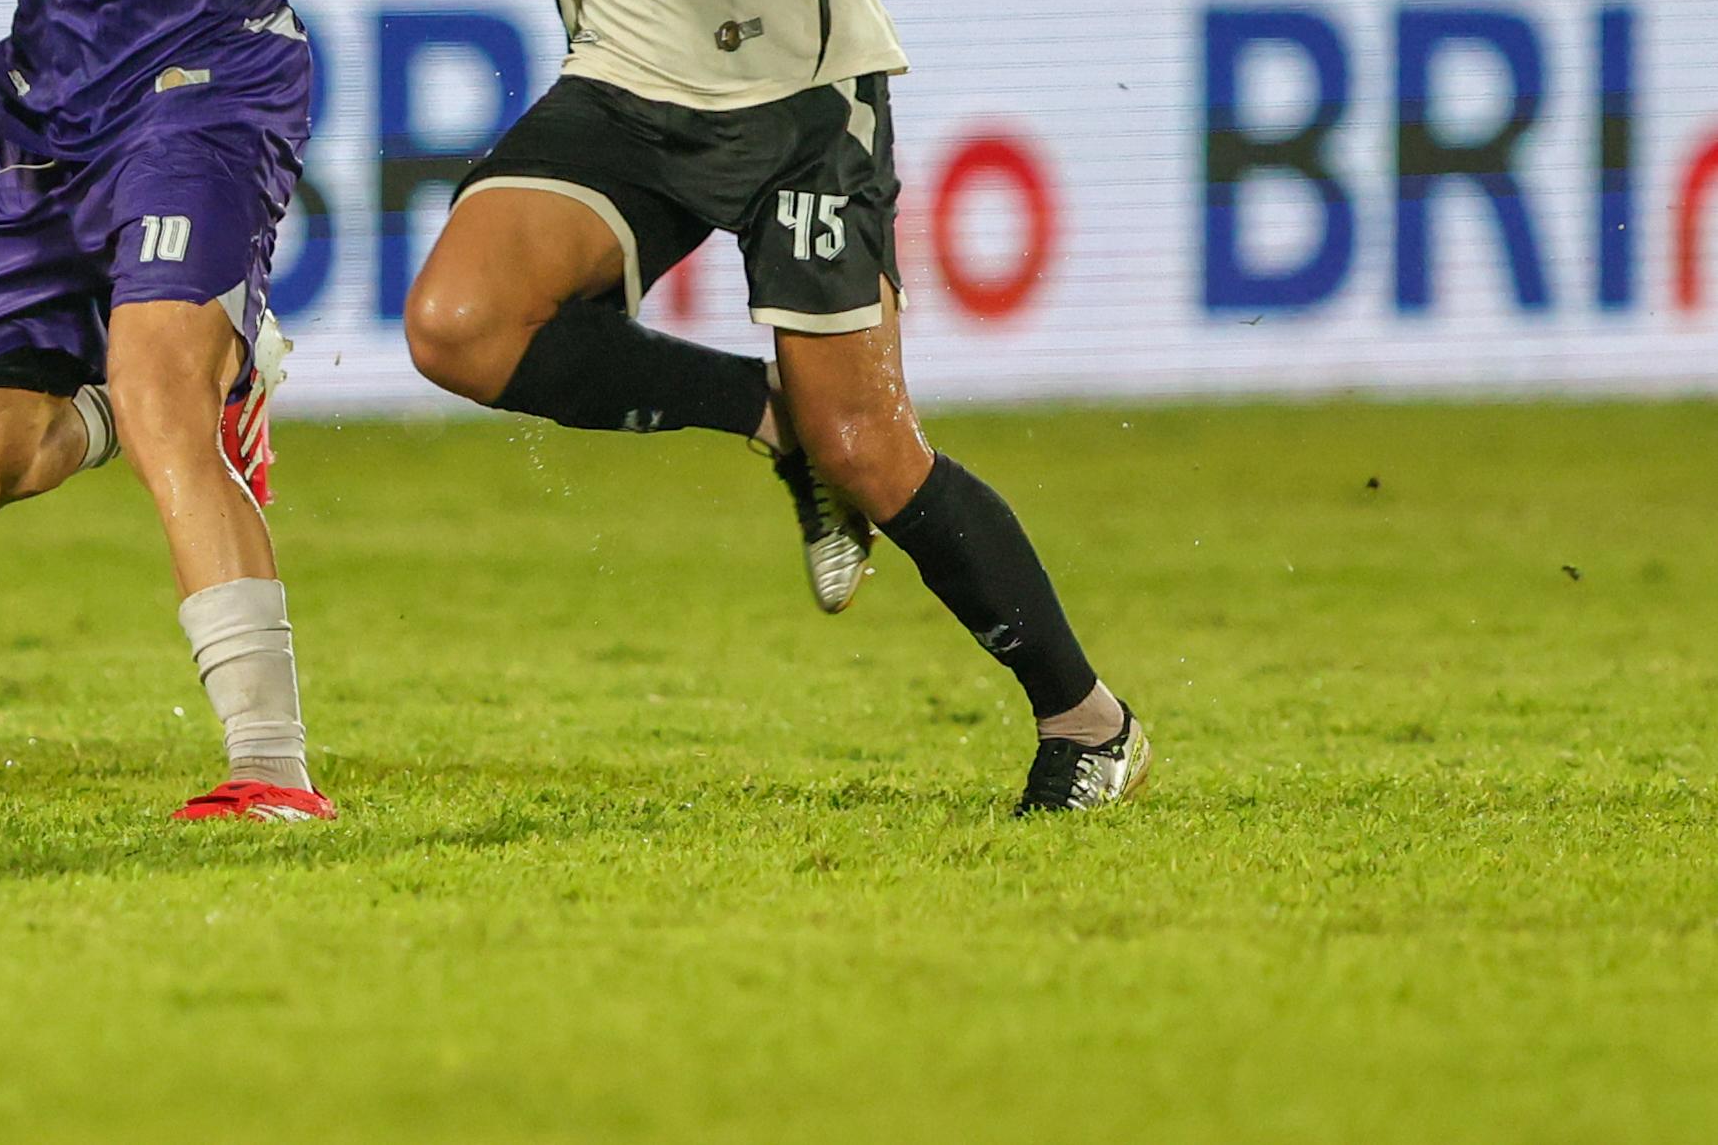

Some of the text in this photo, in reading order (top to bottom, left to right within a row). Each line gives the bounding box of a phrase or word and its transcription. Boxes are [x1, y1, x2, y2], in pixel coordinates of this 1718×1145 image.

[1202, 6, 1718, 314] BRI
[140, 215, 191, 262] 10
[777, 189, 850, 261] 45
